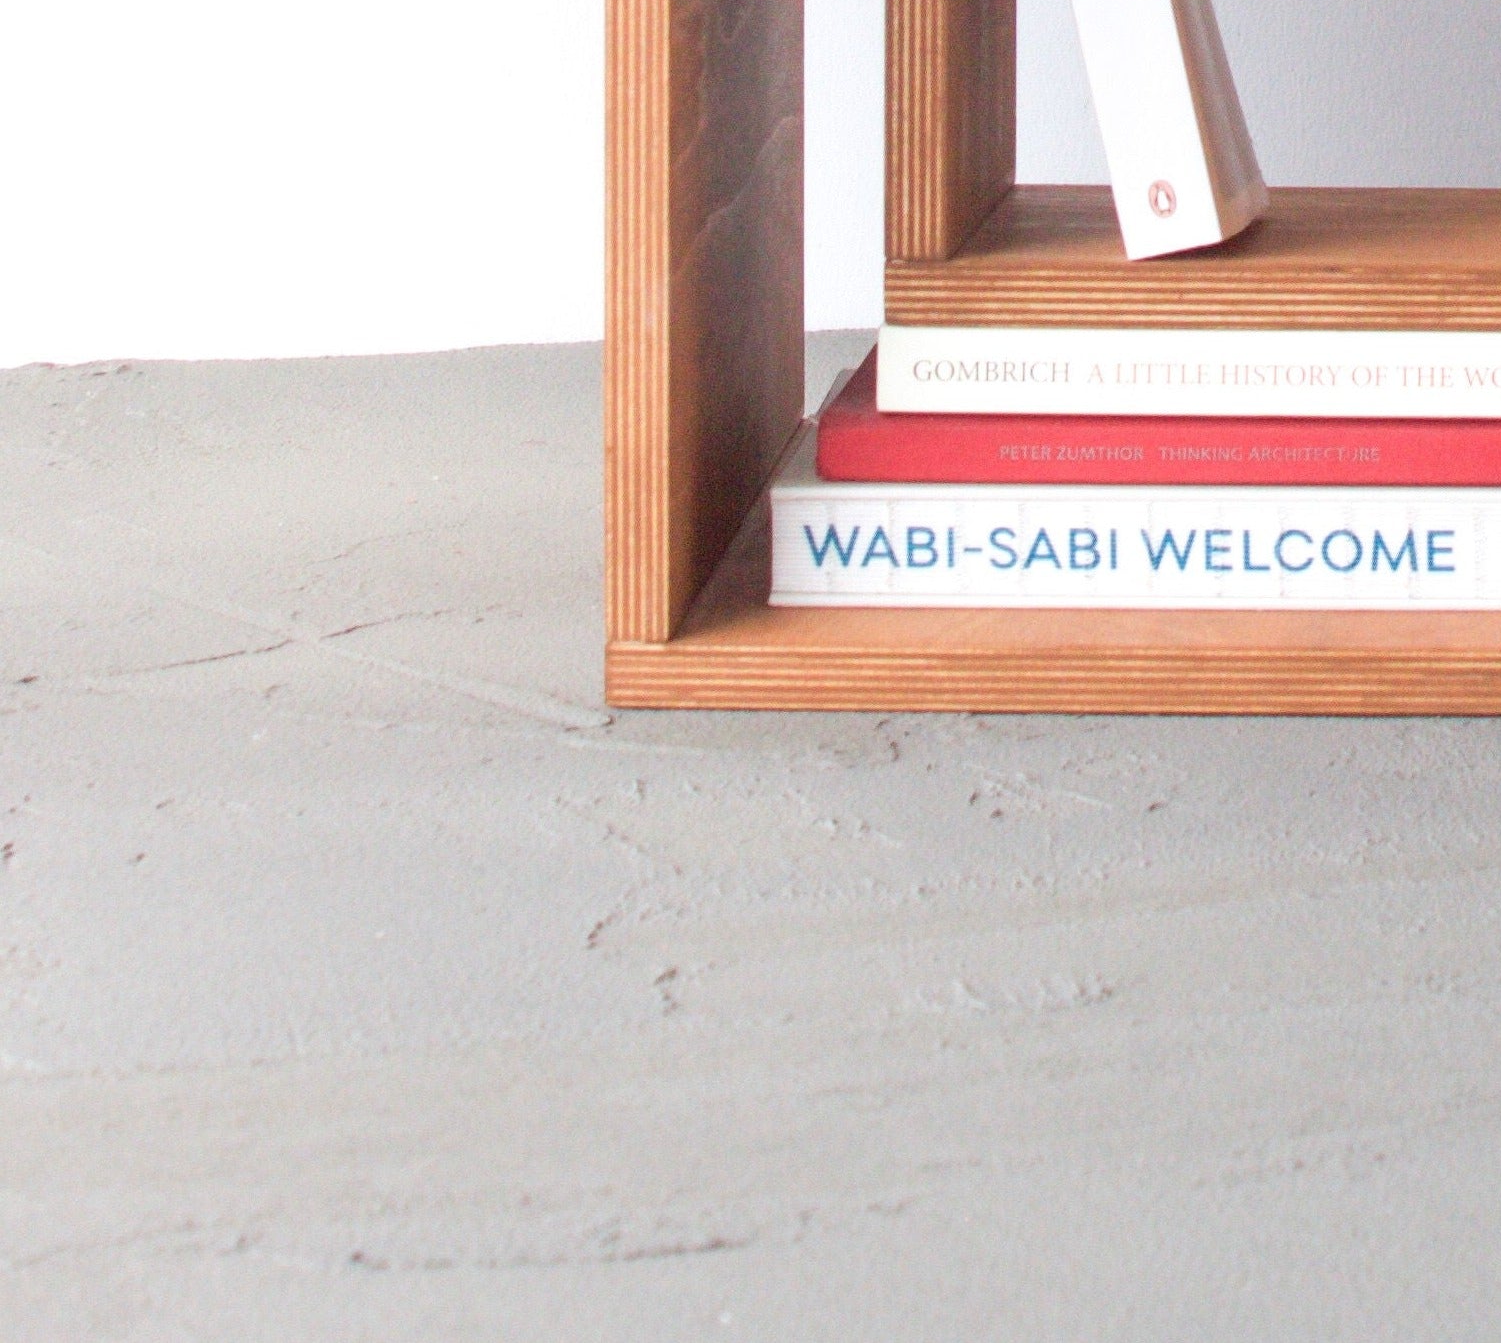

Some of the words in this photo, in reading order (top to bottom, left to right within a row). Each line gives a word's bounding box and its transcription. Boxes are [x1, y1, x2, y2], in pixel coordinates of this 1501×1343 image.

[912, 358, 1071, 383] GOMBRICH
[1087, 362, 1105, 385] A
[1115, 363, 1211, 386] LITTLE
[1220, 364, 1342, 387] HISTORY
[1350, 365, 1389, 388] OF
[1394, 365, 1455, 389] THE
[999, 444, 1051, 462] PETER
[1056, 445, 1145, 462] ZUMTHOR
[1159, 445, 1241, 462] THINKING
[803, 525, 1117, 571] WABI-SABI
[1140, 529, 1456, 572] WELCOME
